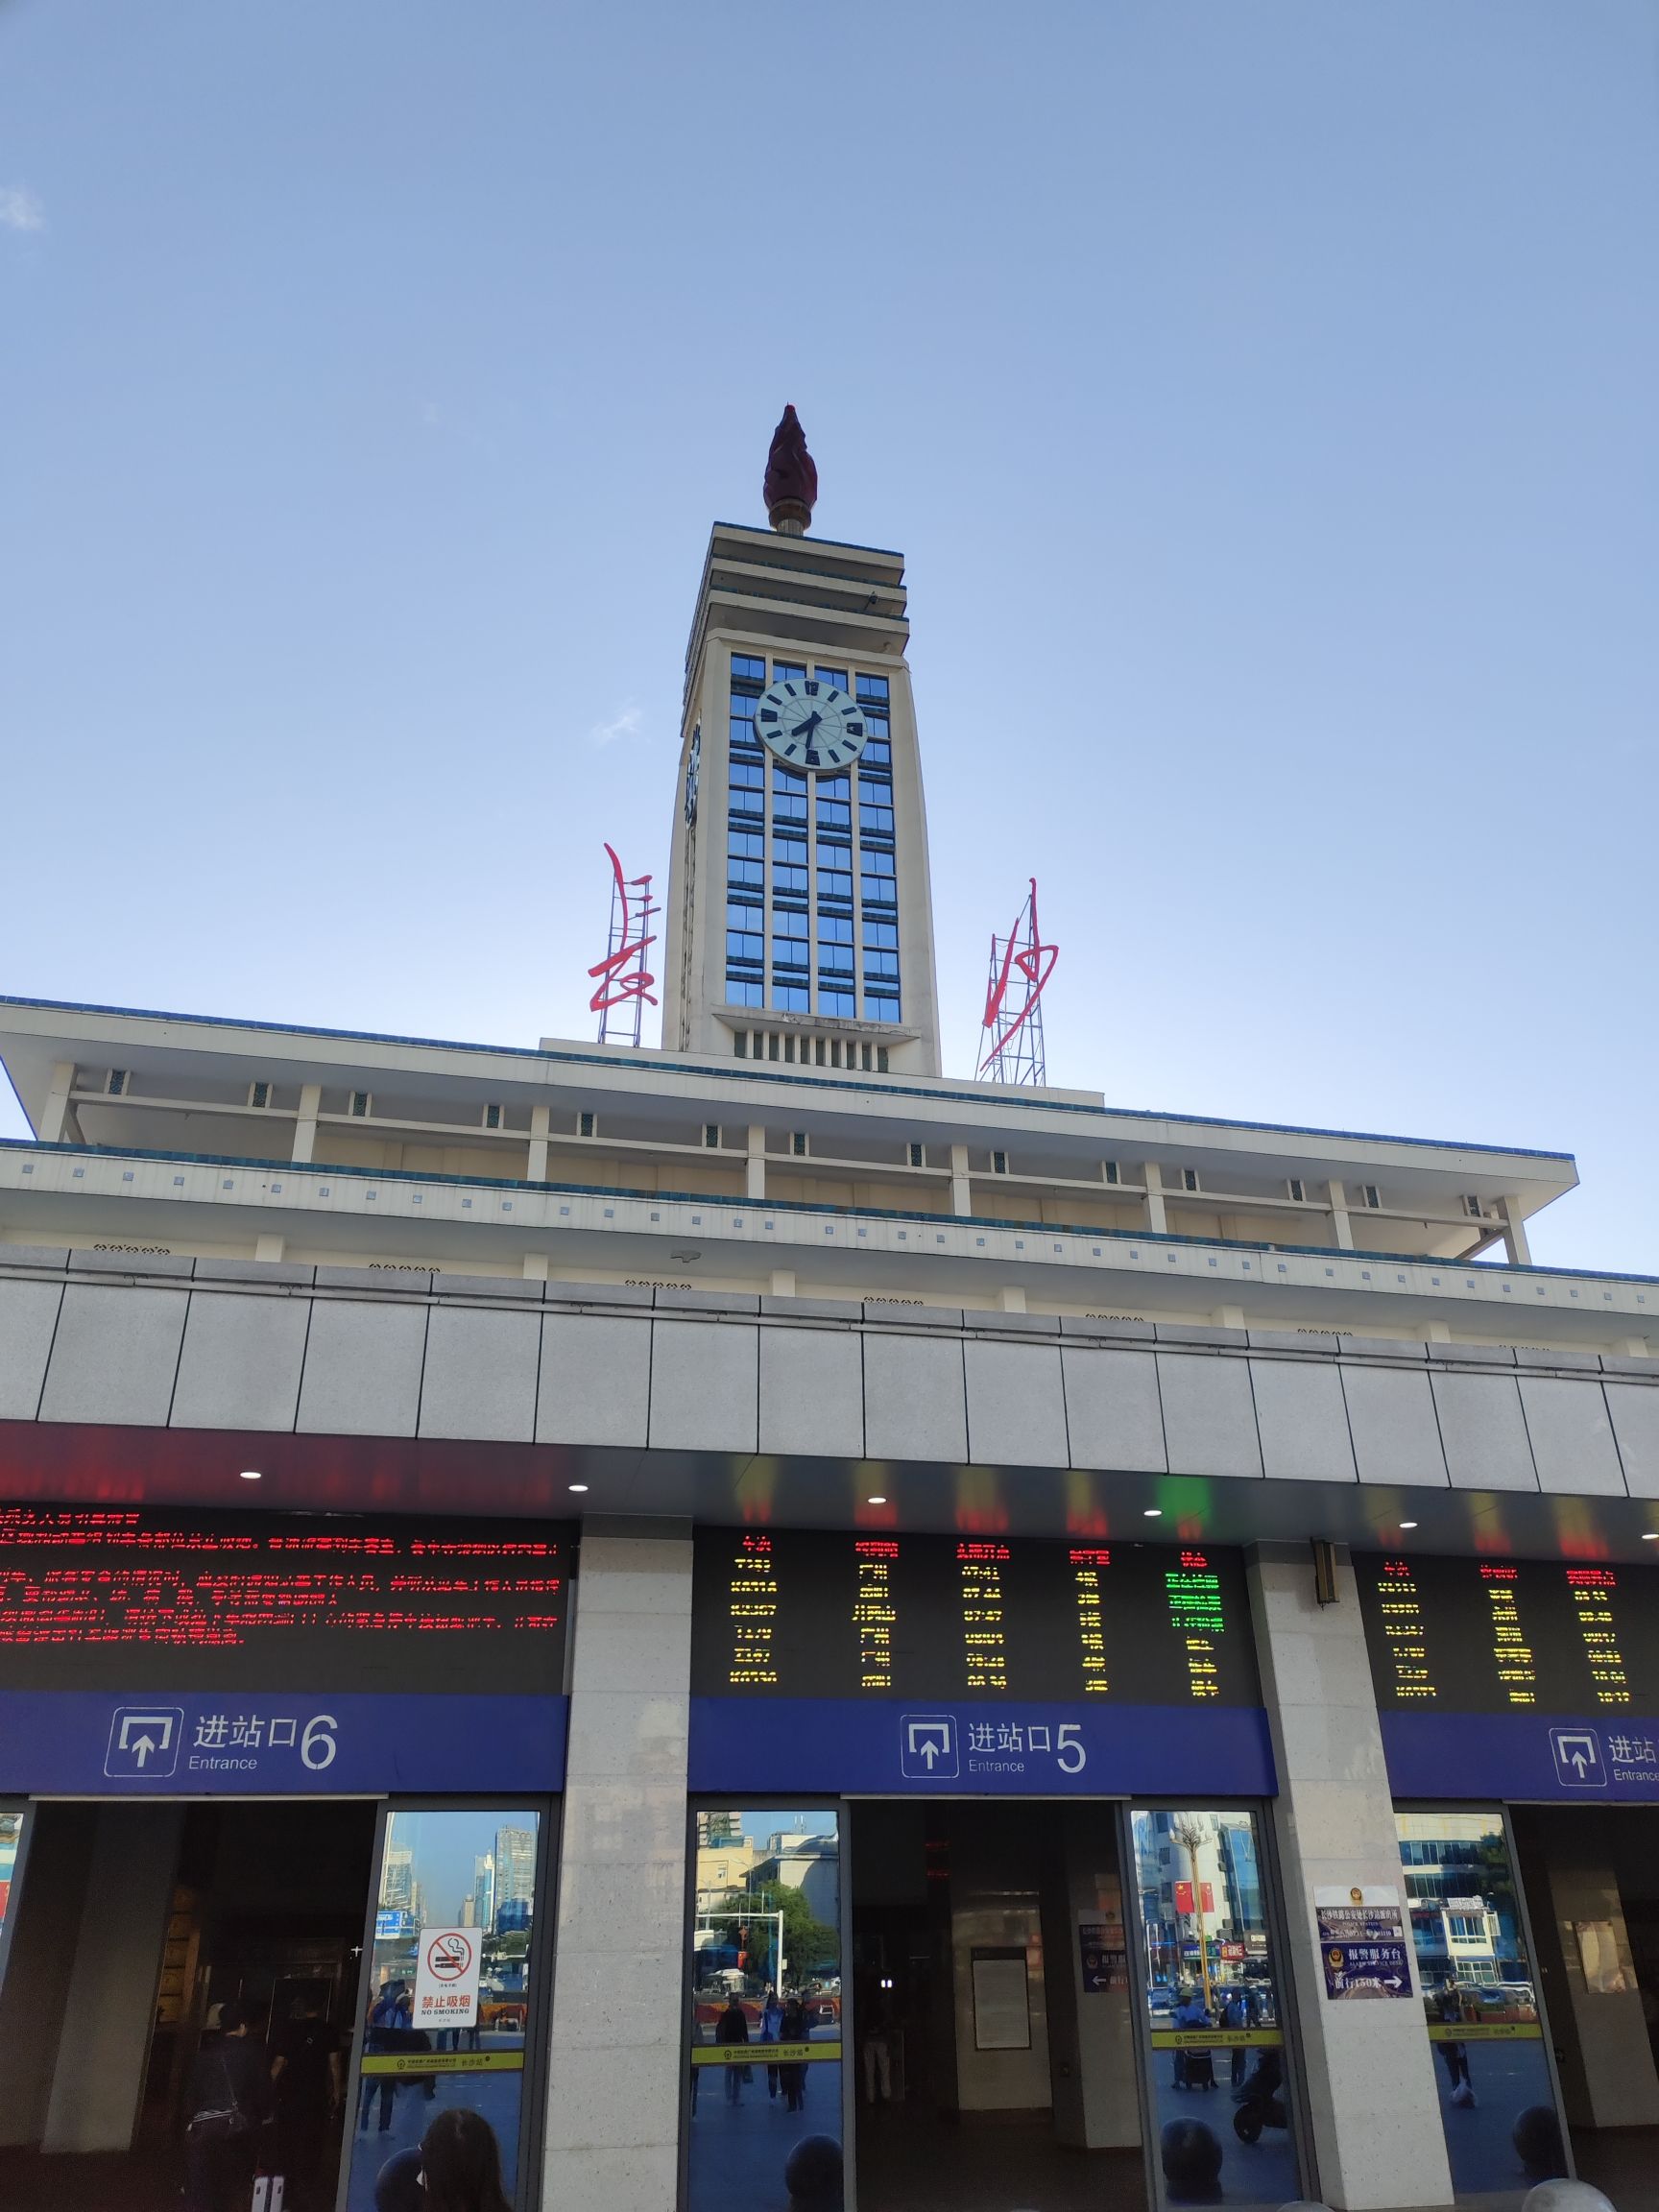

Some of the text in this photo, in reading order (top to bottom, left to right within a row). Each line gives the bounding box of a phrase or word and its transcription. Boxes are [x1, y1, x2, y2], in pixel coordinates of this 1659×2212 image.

[193, 1714, 297, 1748] 进站口
[968, 1721, 1051, 1752] 进站口
[301, 1715, 338, 1770] 6
[1057, 1723, 1087, 1773] 5
[188, 1755, 258, 1769] Entrance
[969, 1759, 1025, 1772] Entrance
[1348, 1948, 1401, 1960] 报警服务台
[421, 1994, 470, 2008] 禁止吸烟
